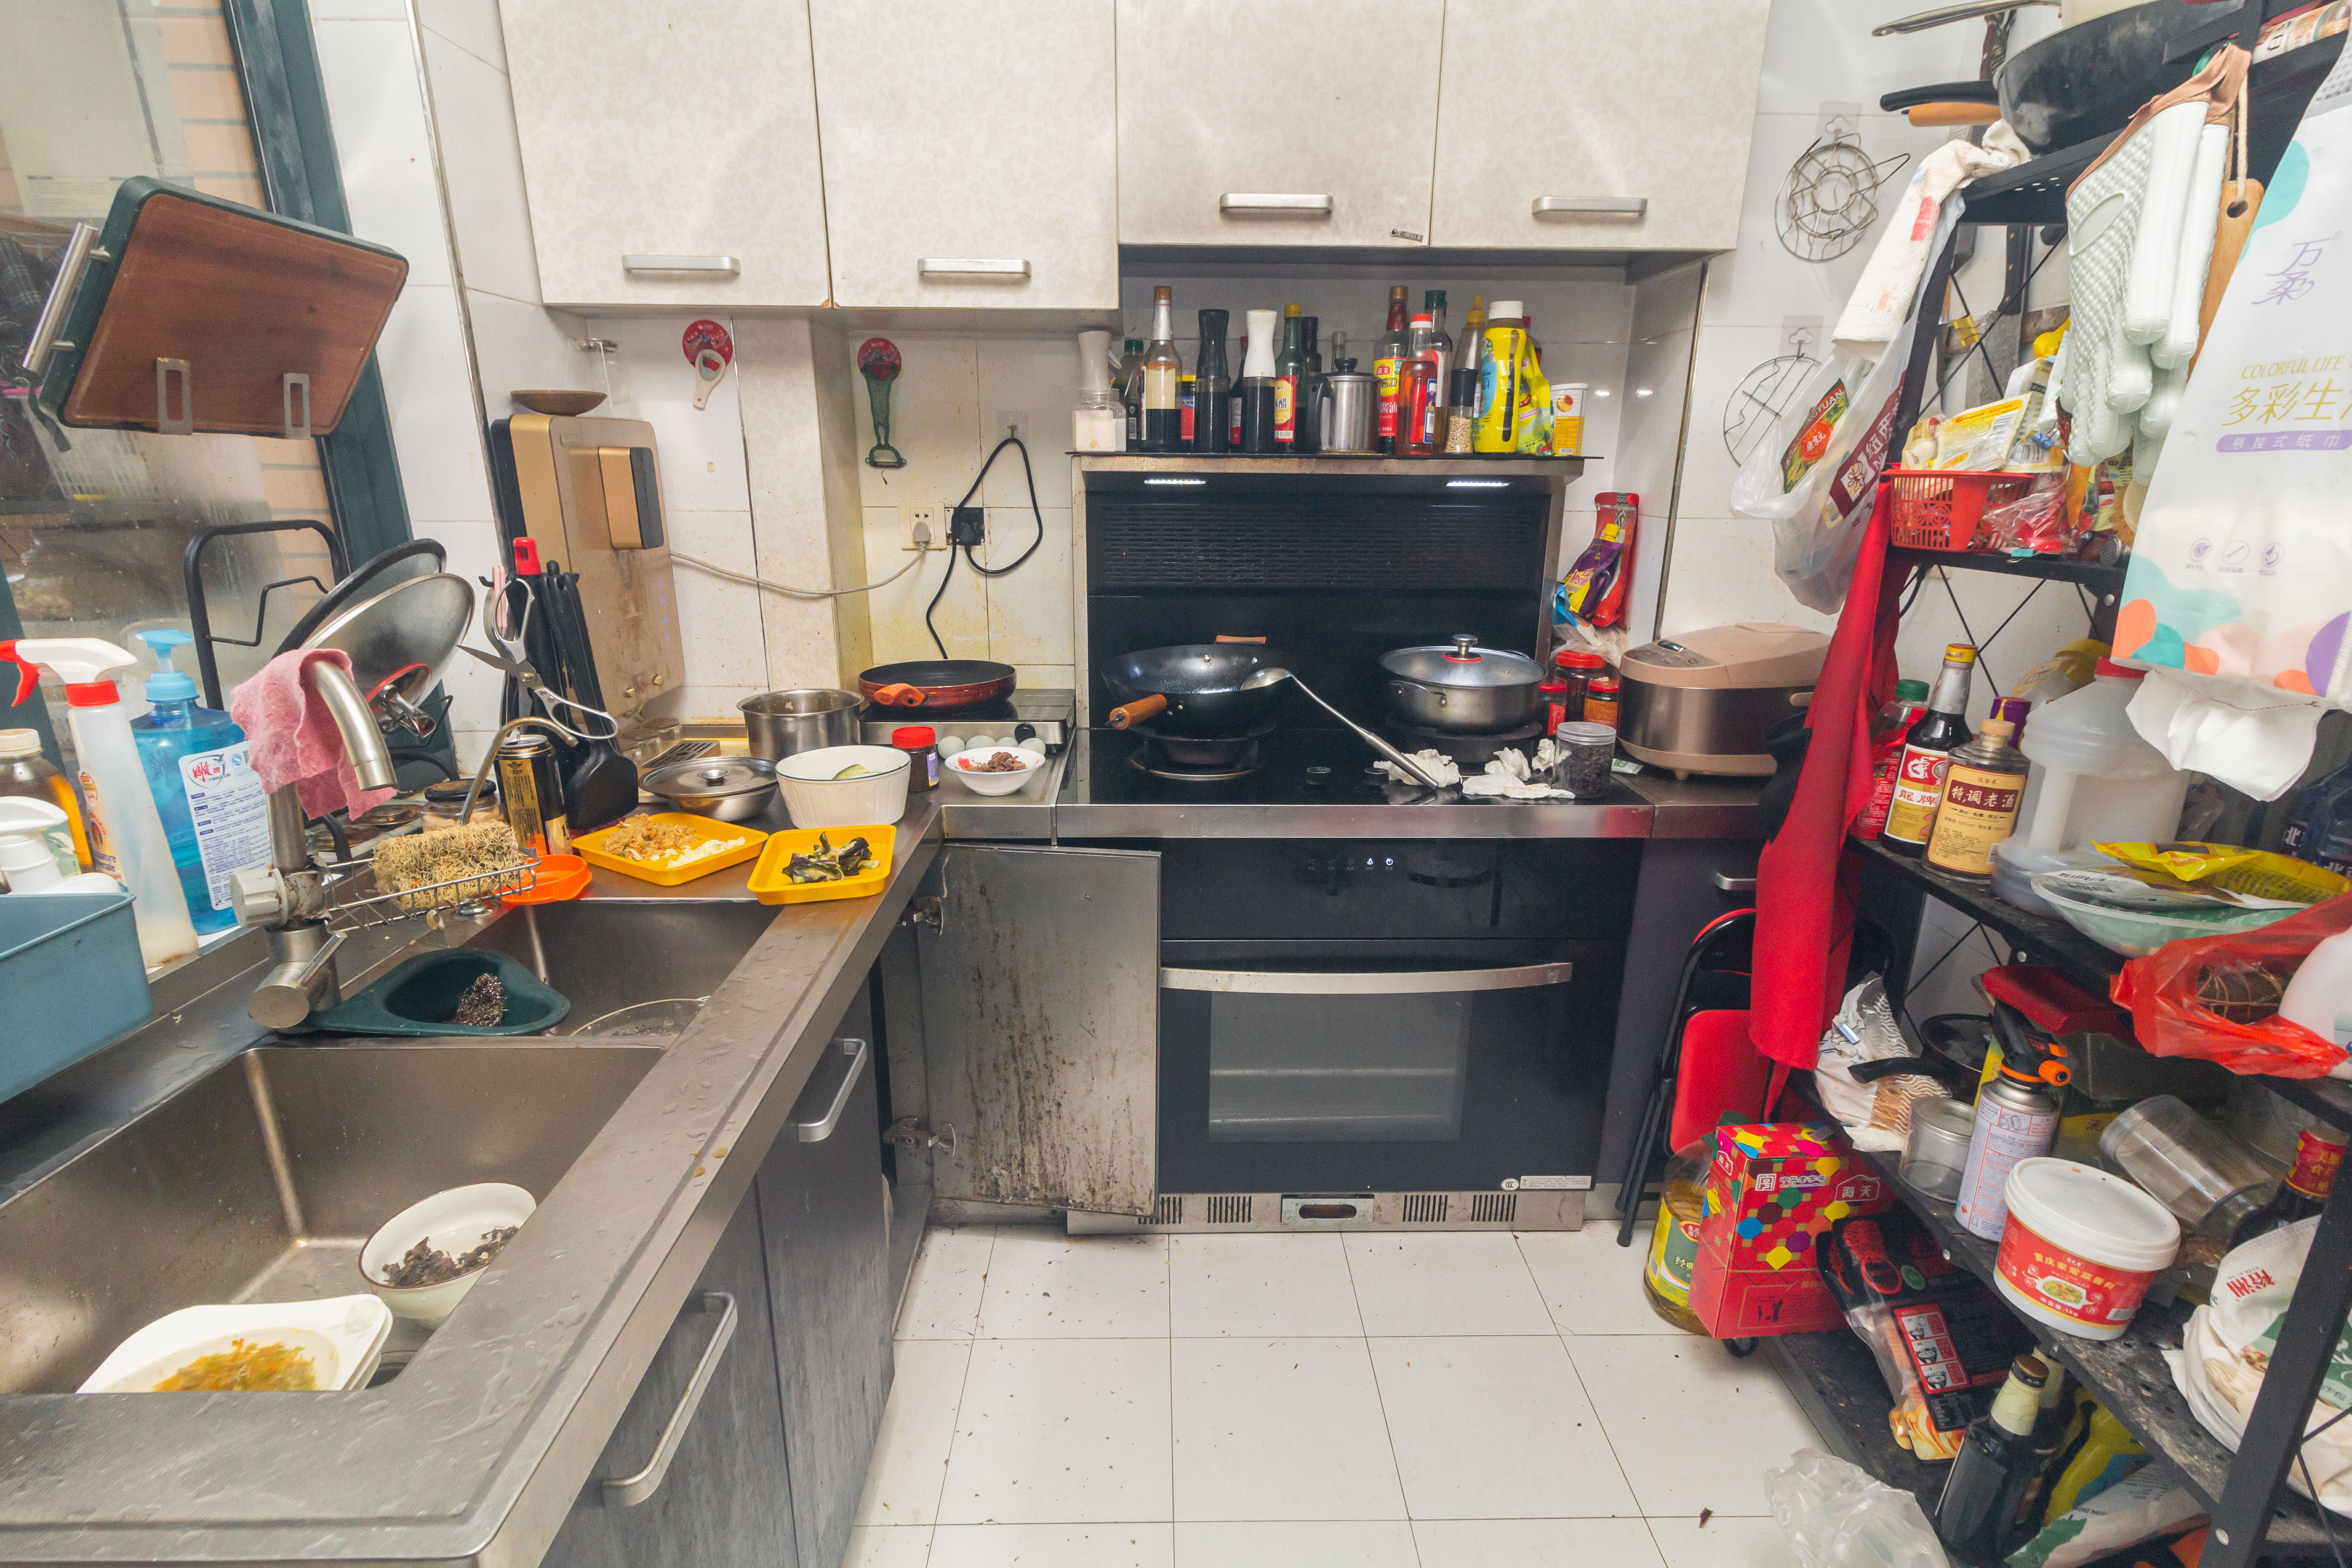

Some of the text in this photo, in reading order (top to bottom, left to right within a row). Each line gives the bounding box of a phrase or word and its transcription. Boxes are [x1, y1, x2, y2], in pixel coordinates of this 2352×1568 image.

[2251, 237, 2331, 305] 万柔
[2241, 355, 2346, 380] COLORFUL LIFE
[1380, 401, 1398, 413] 酱油
[2230, 433, 2340, 451] 悬挂式纸巾
[1898, 789, 1936, 806] 龍牌
[1951, 785, 2015, 808] 特调老酒
[1718, 1154, 1730, 1171] 海天
[1779, 1175, 1826, 1184] 中华老字号
[1842, 1186, 1872, 1198] 海天
[2034, 1252, 2116, 1291] 重庆家常菜酱料
